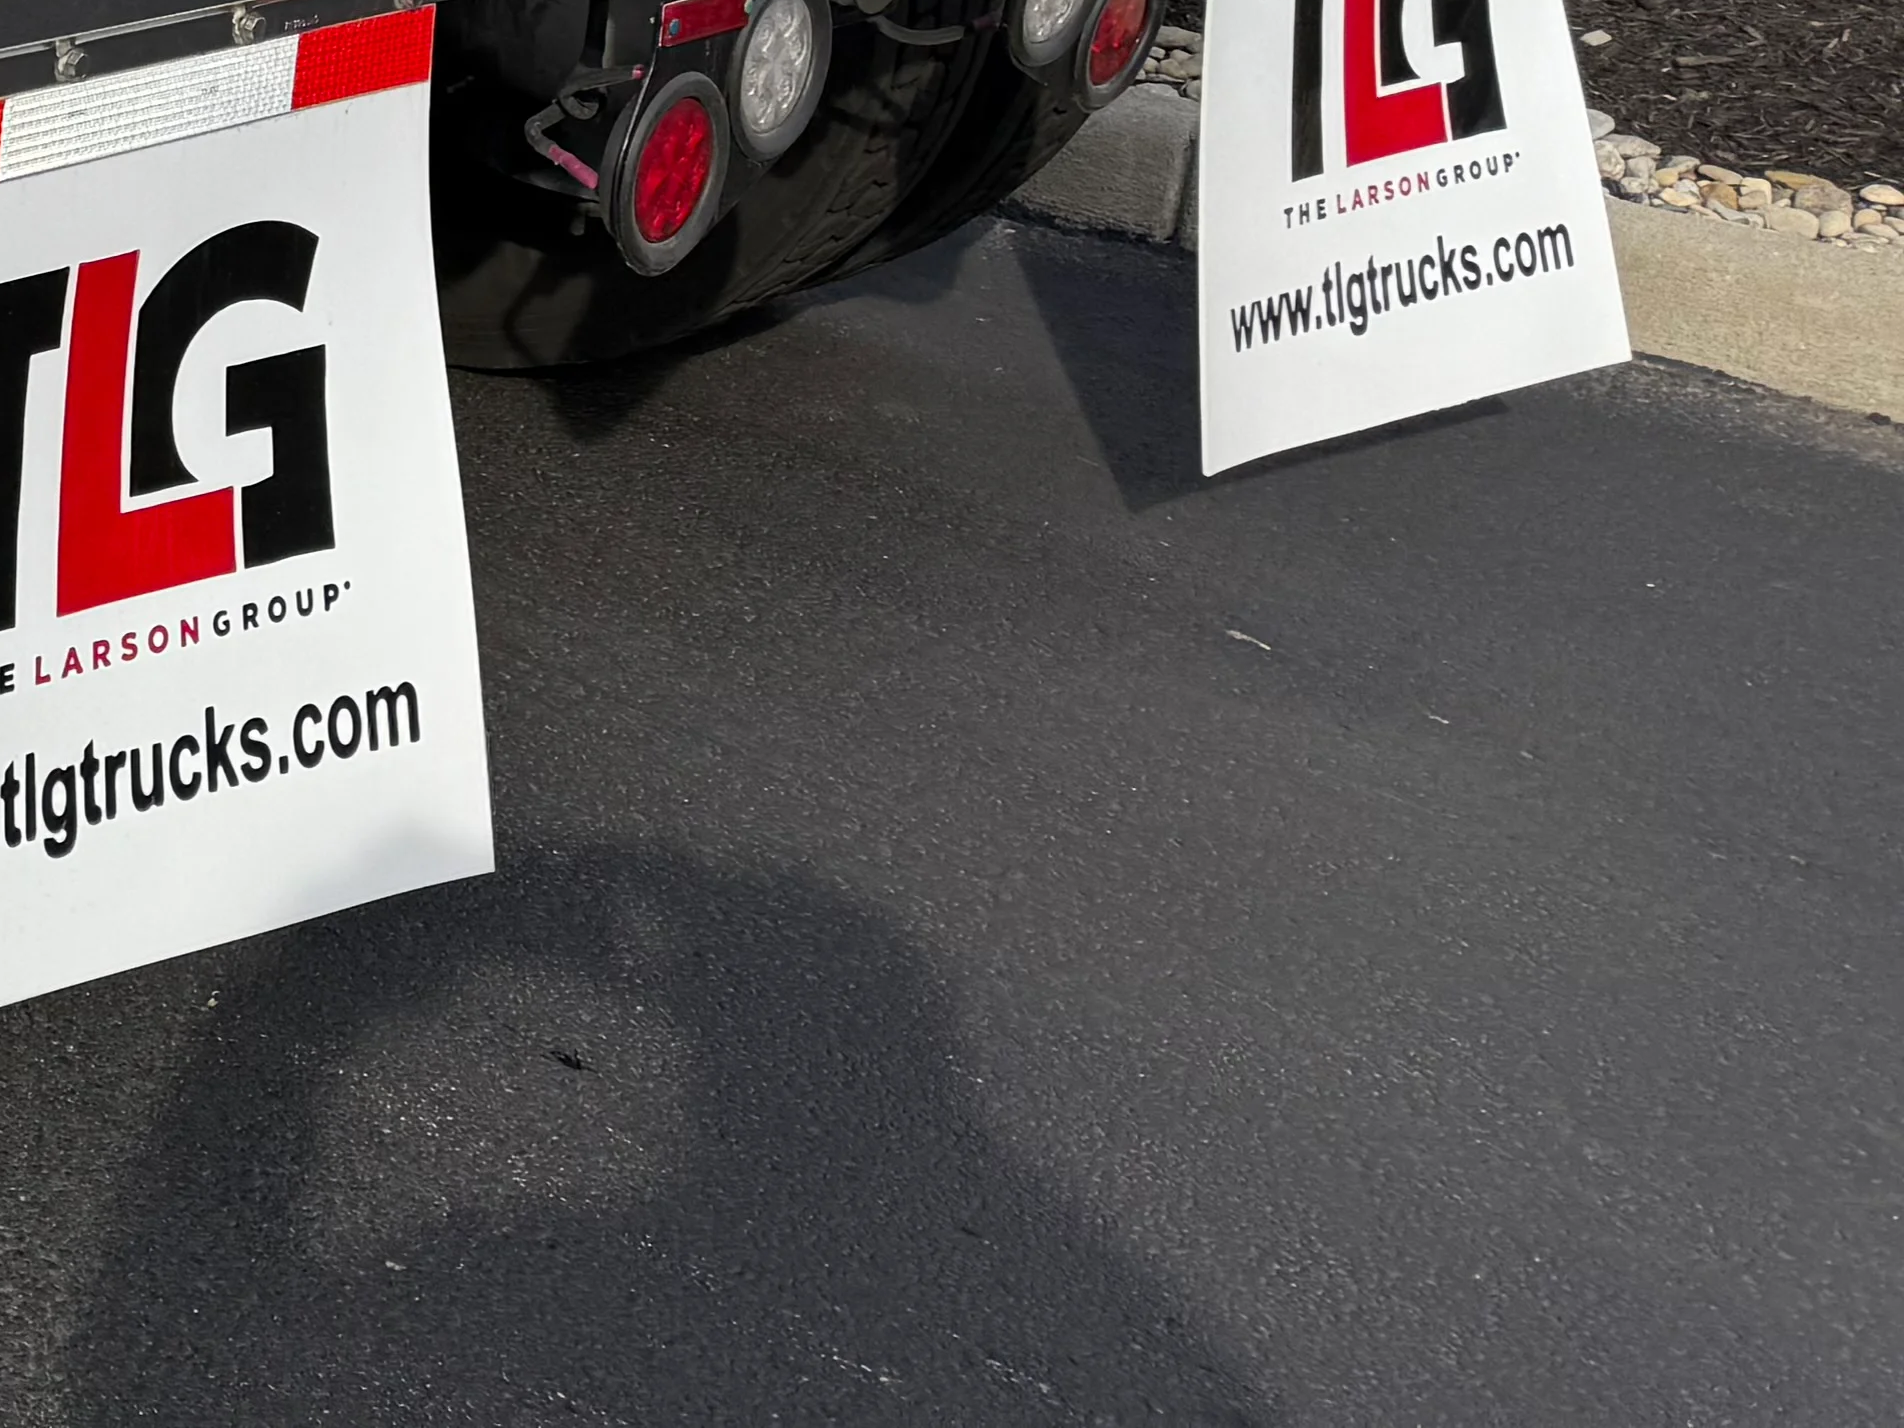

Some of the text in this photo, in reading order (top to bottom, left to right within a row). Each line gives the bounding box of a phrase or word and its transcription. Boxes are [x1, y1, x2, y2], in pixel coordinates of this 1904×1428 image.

[1283, 153, 1514, 229] THE LARSON GROUP
[1230, 221, 1574, 353] www.tlgtrucks.com
[34, 616, 201, 687] LARSON
[212, 581, 342, 638] GROUP
